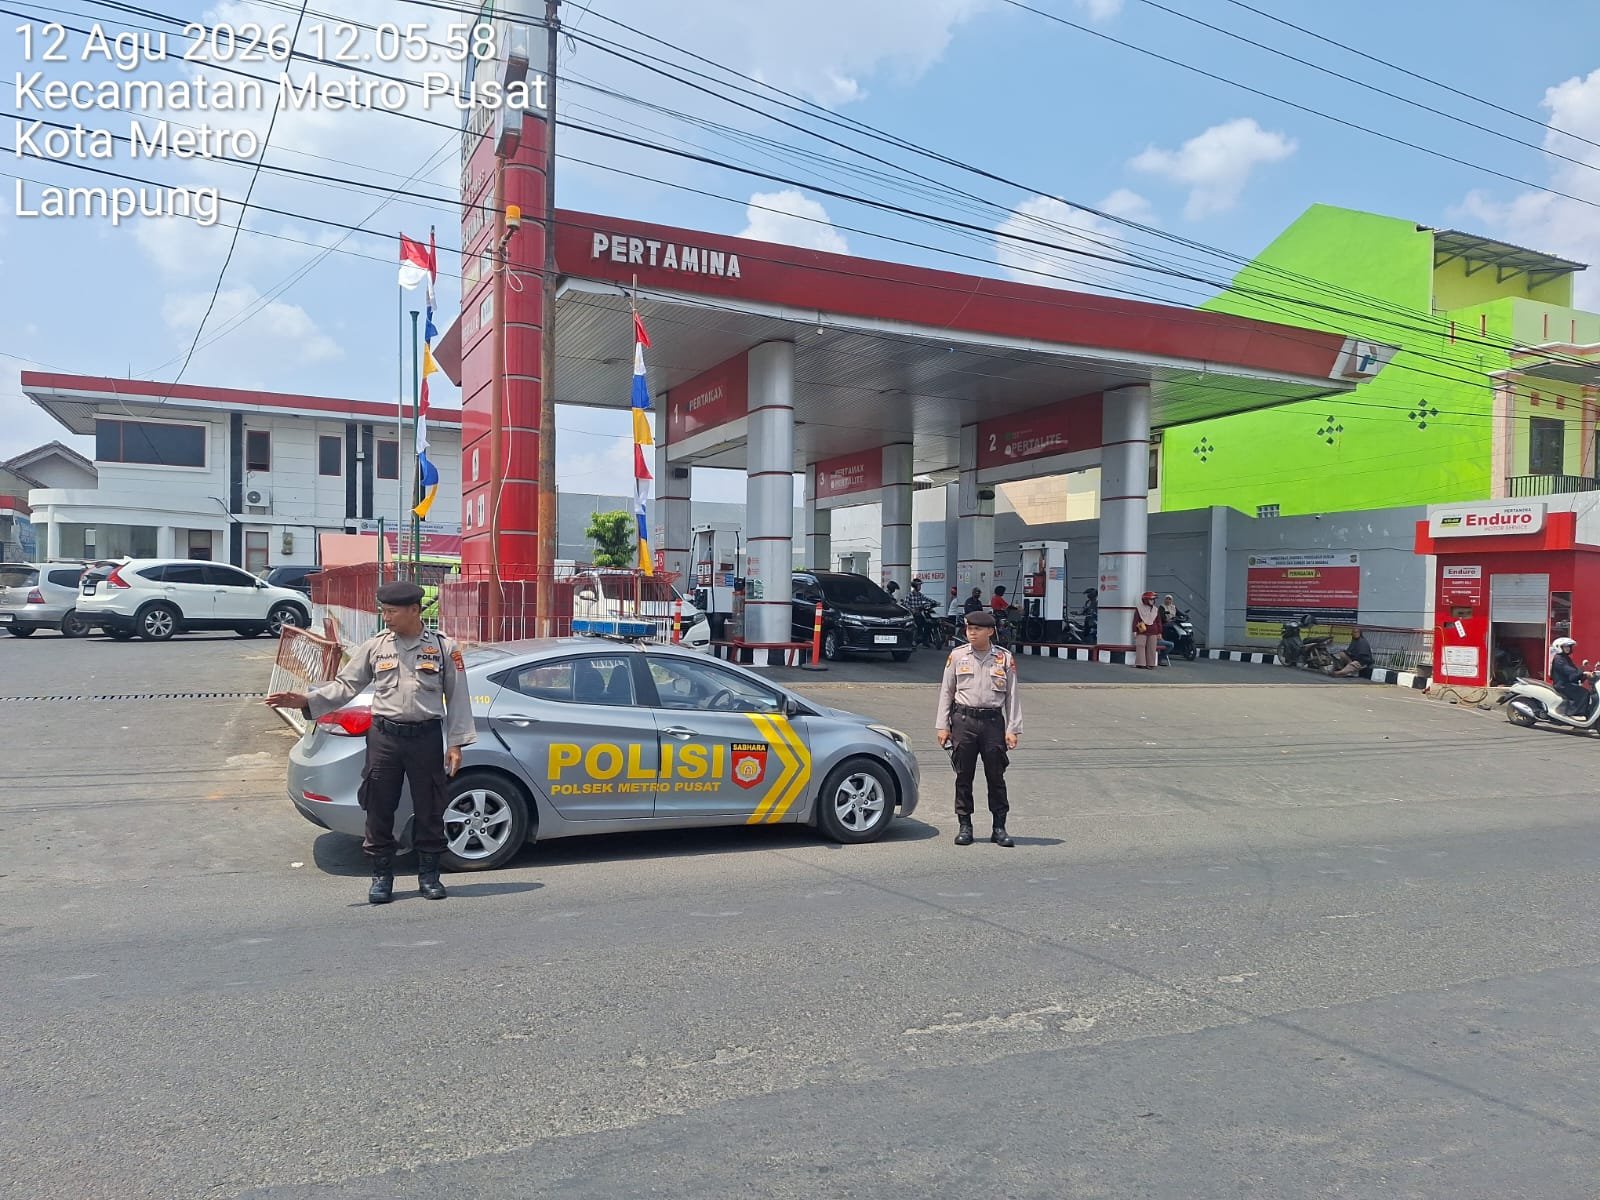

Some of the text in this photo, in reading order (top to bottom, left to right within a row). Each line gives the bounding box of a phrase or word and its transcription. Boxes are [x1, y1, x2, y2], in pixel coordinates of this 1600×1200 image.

[592, 232, 741, 278] PERTAMINA
[673, 403, 679, 424] 1
[988, 433, 1063, 453] 2 PERTALITE
[819, 471, 825, 486] 3
[1465, 512, 1533, 526] Enduro
[474, 695, 490, 705] 110
[733, 743, 766, 751] SABHARA
[547, 743, 724, 780] POLISI
[551, 781, 722, 796] POLSEK METRO PUSAT
